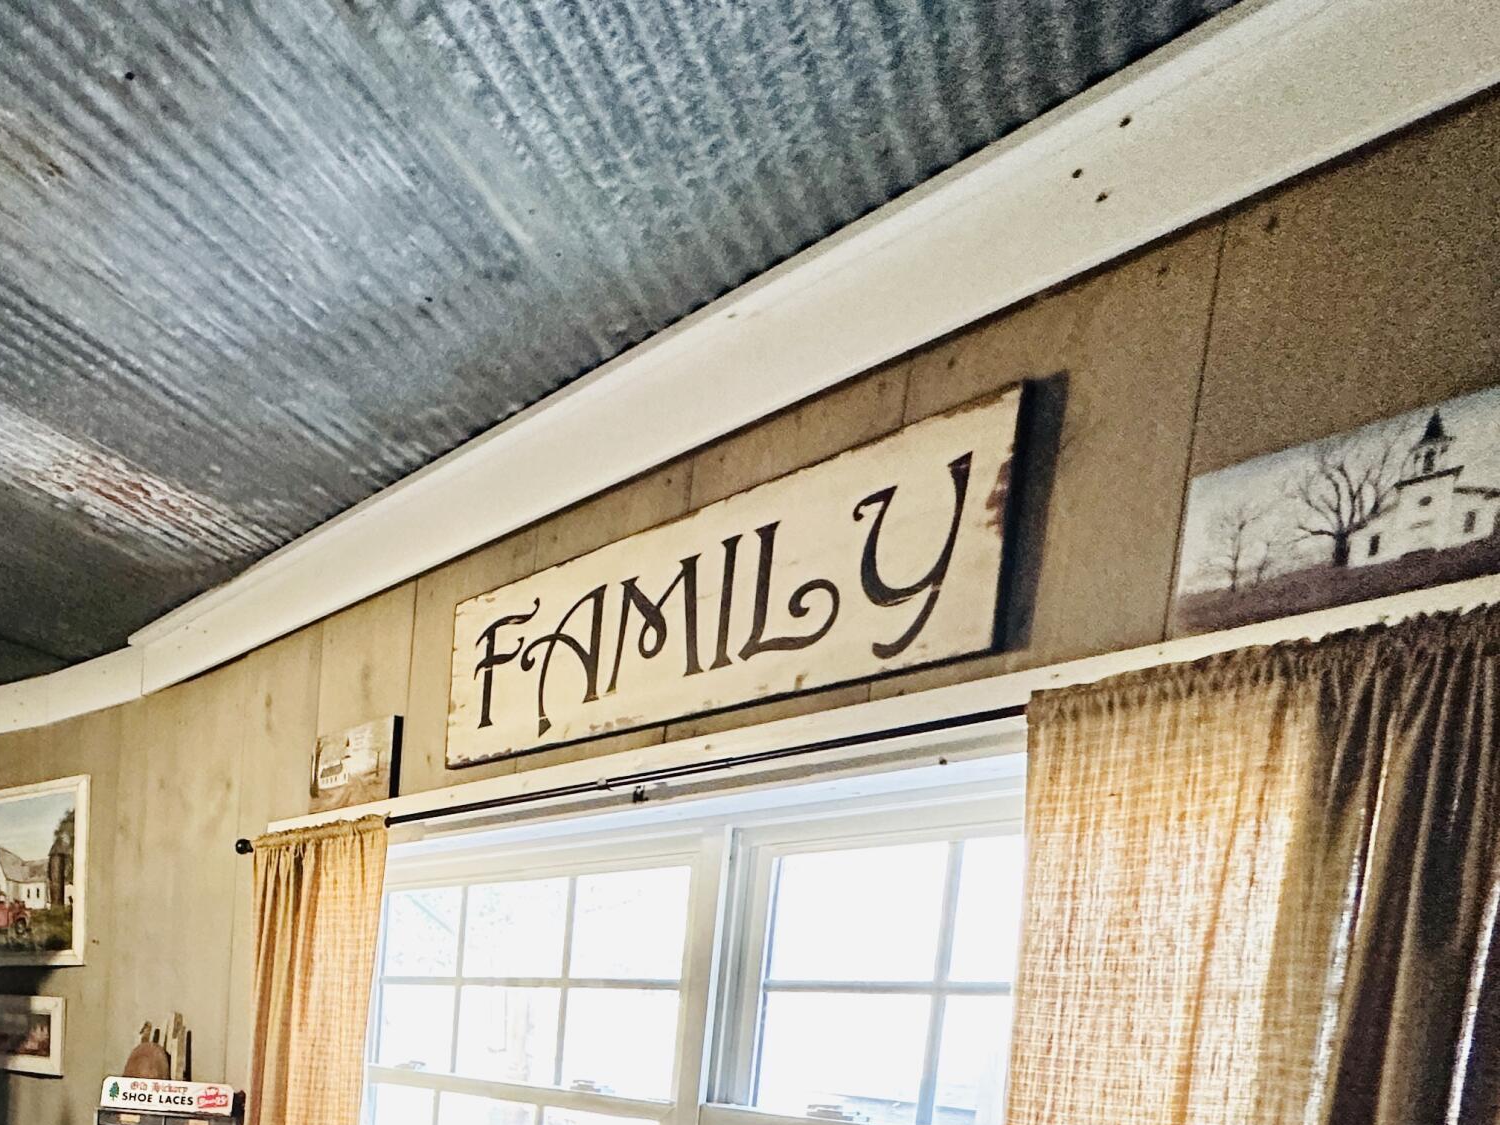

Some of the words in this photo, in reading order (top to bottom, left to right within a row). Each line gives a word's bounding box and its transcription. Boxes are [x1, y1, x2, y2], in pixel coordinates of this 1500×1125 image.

[474, 451, 973, 738] FAMILY
[122, 1091, 153, 1103] SHOE
[159, 1095, 194, 1106] LACES
